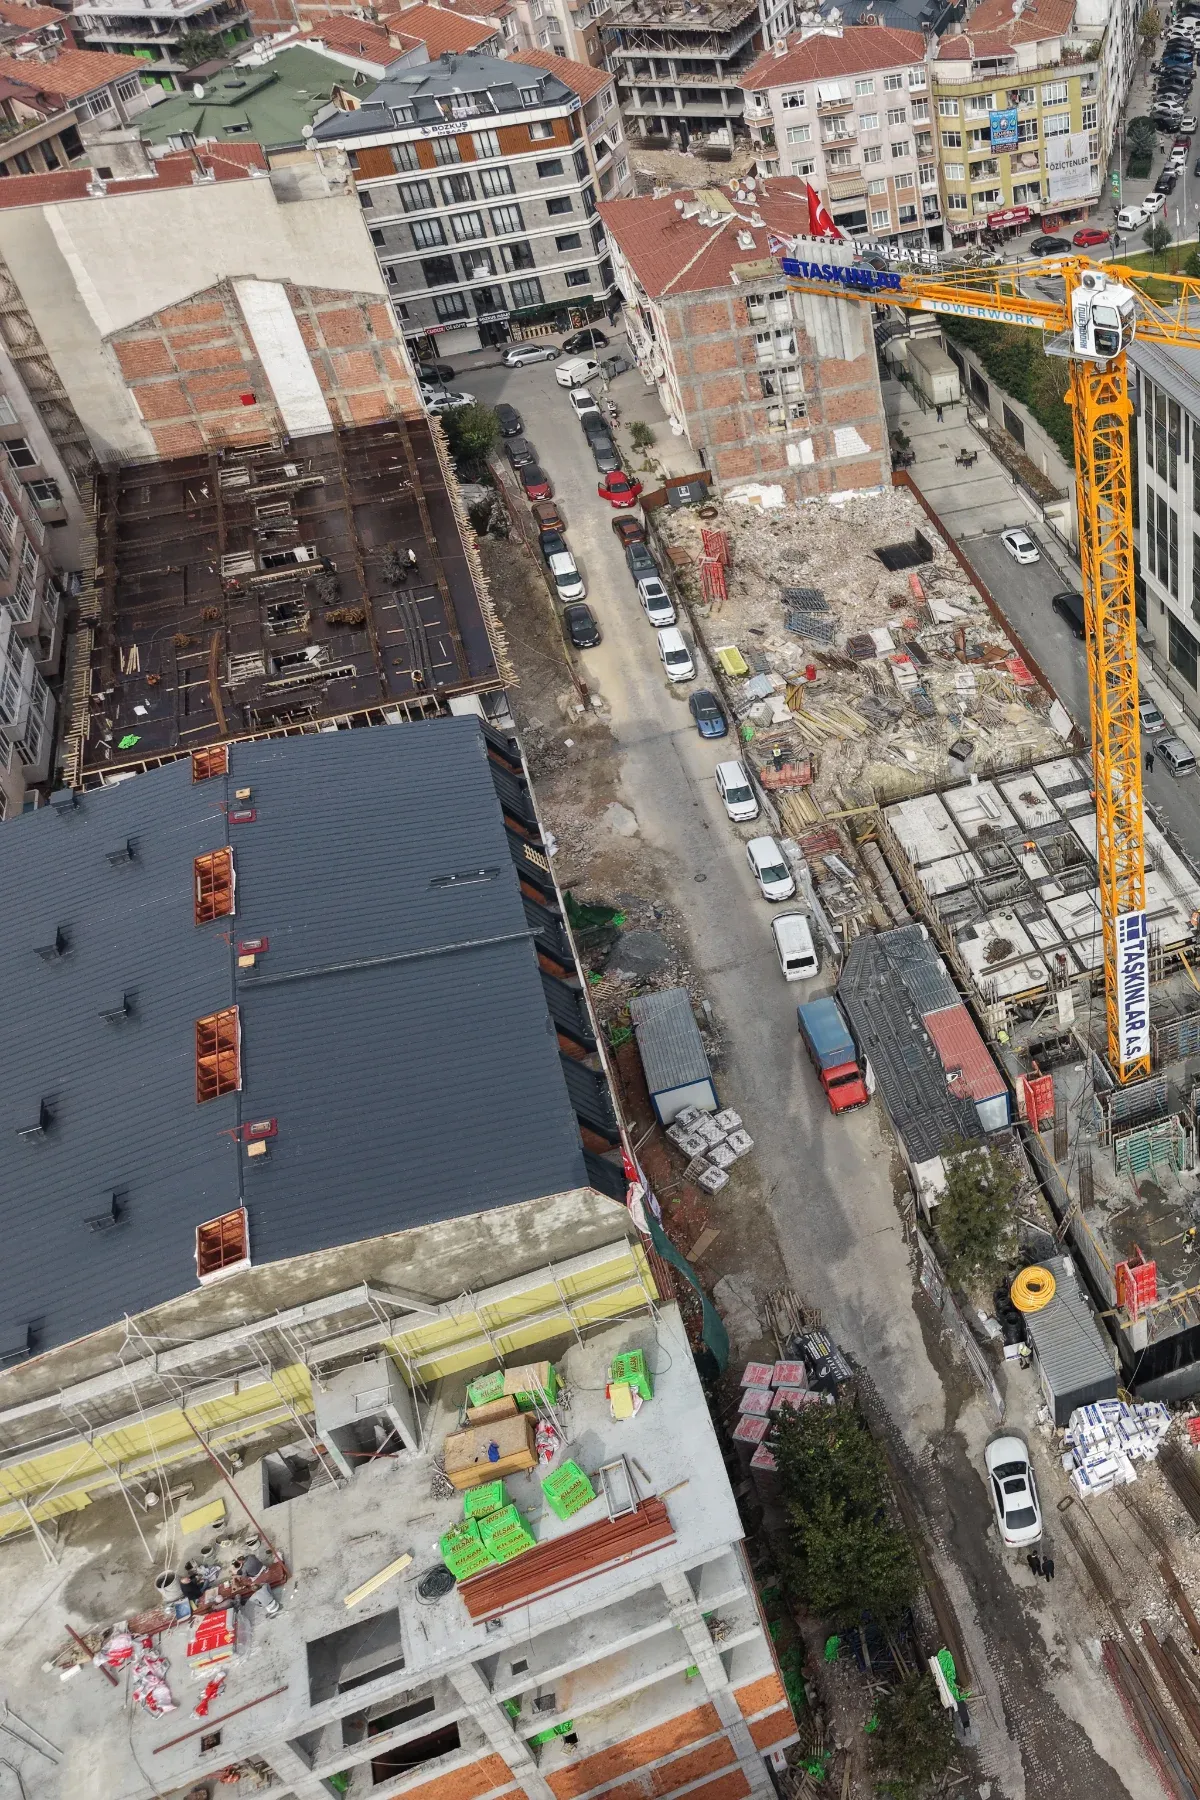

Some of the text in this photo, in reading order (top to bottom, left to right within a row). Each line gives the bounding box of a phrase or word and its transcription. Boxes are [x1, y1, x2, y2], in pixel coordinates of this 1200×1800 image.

[1049, 156, 1089, 171] ÖZİÇTENLER
[799, 261, 903, 290] TAŞKINLAR
[930, 300, 1035, 325] TOWERWORK
[1120, 939, 1146, 1033] TAŞKINLAR
[492, 1523, 515, 1538] KILSAN
